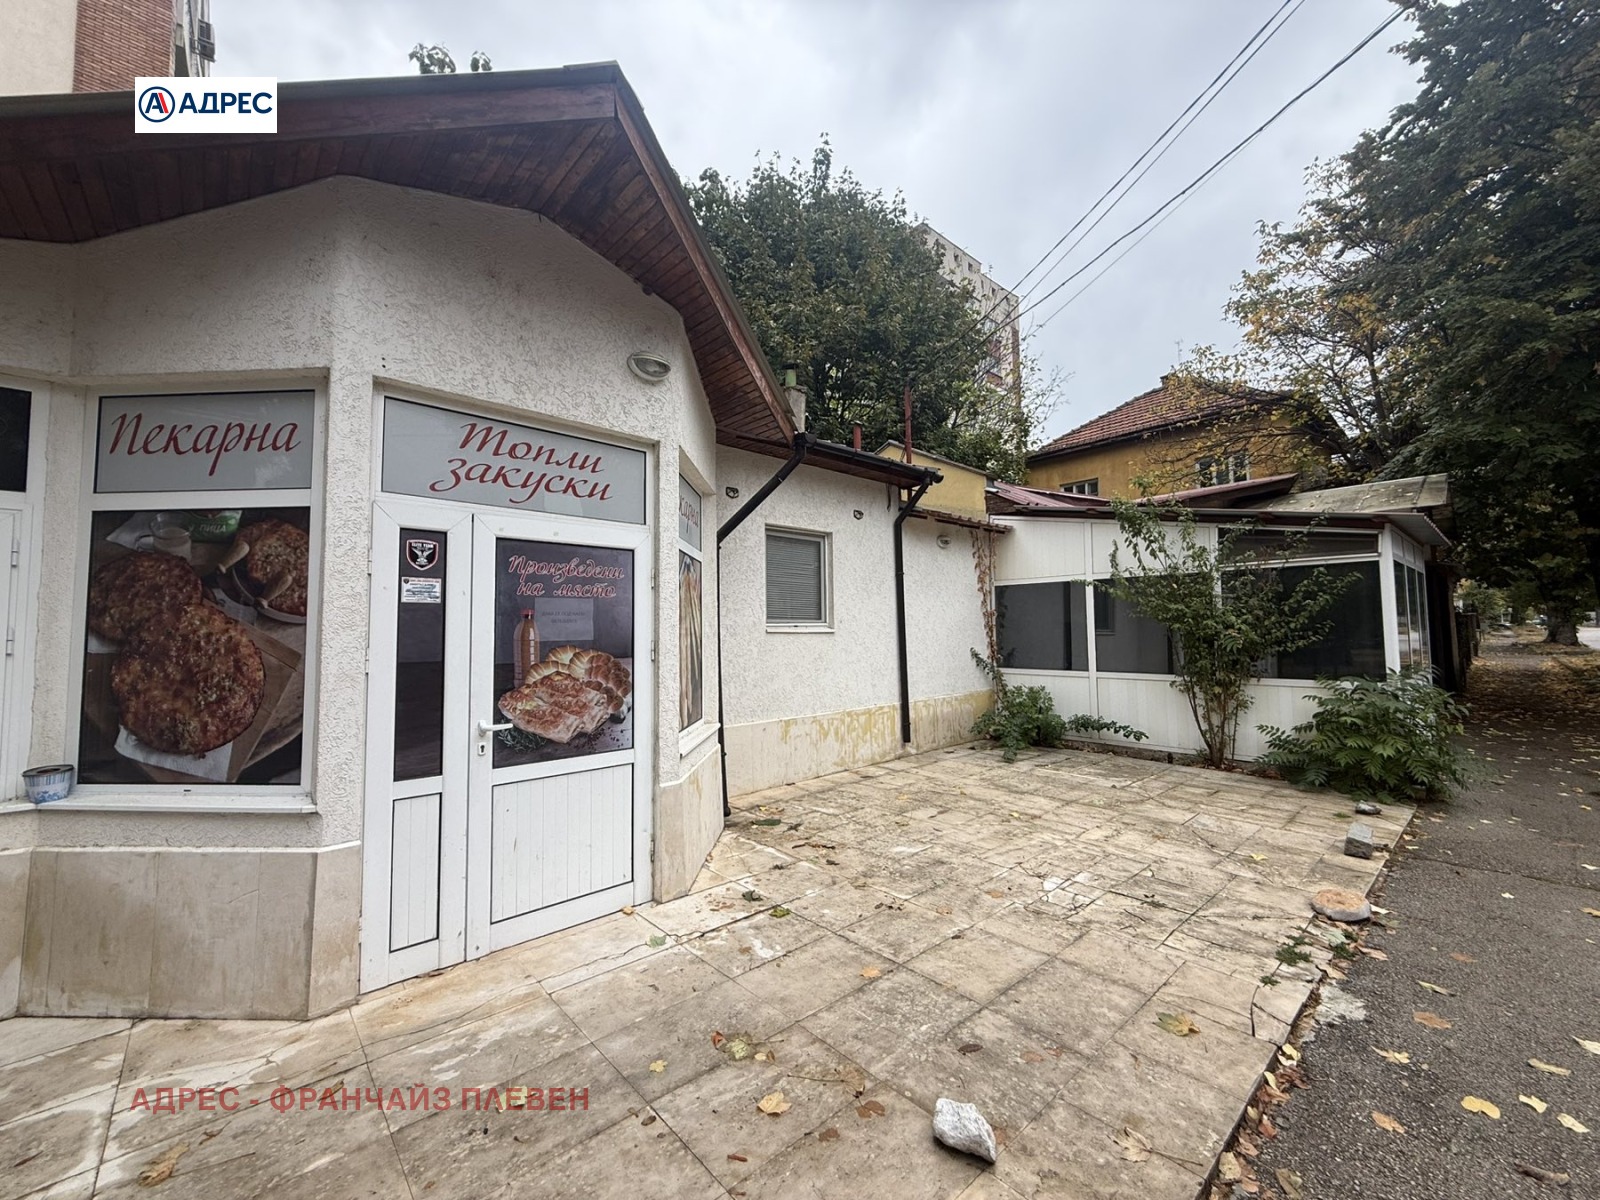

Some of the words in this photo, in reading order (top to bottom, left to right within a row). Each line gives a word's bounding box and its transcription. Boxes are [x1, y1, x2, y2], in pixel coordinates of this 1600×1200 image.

[109, 413, 301, 476] Пекарна
[459, 423, 605, 473] Топли
[429, 458, 613, 504] закуски
[508, 555, 625, 583] Произведени
[516, 582, 545, 596] на
[553, 583, 617, 598] място
